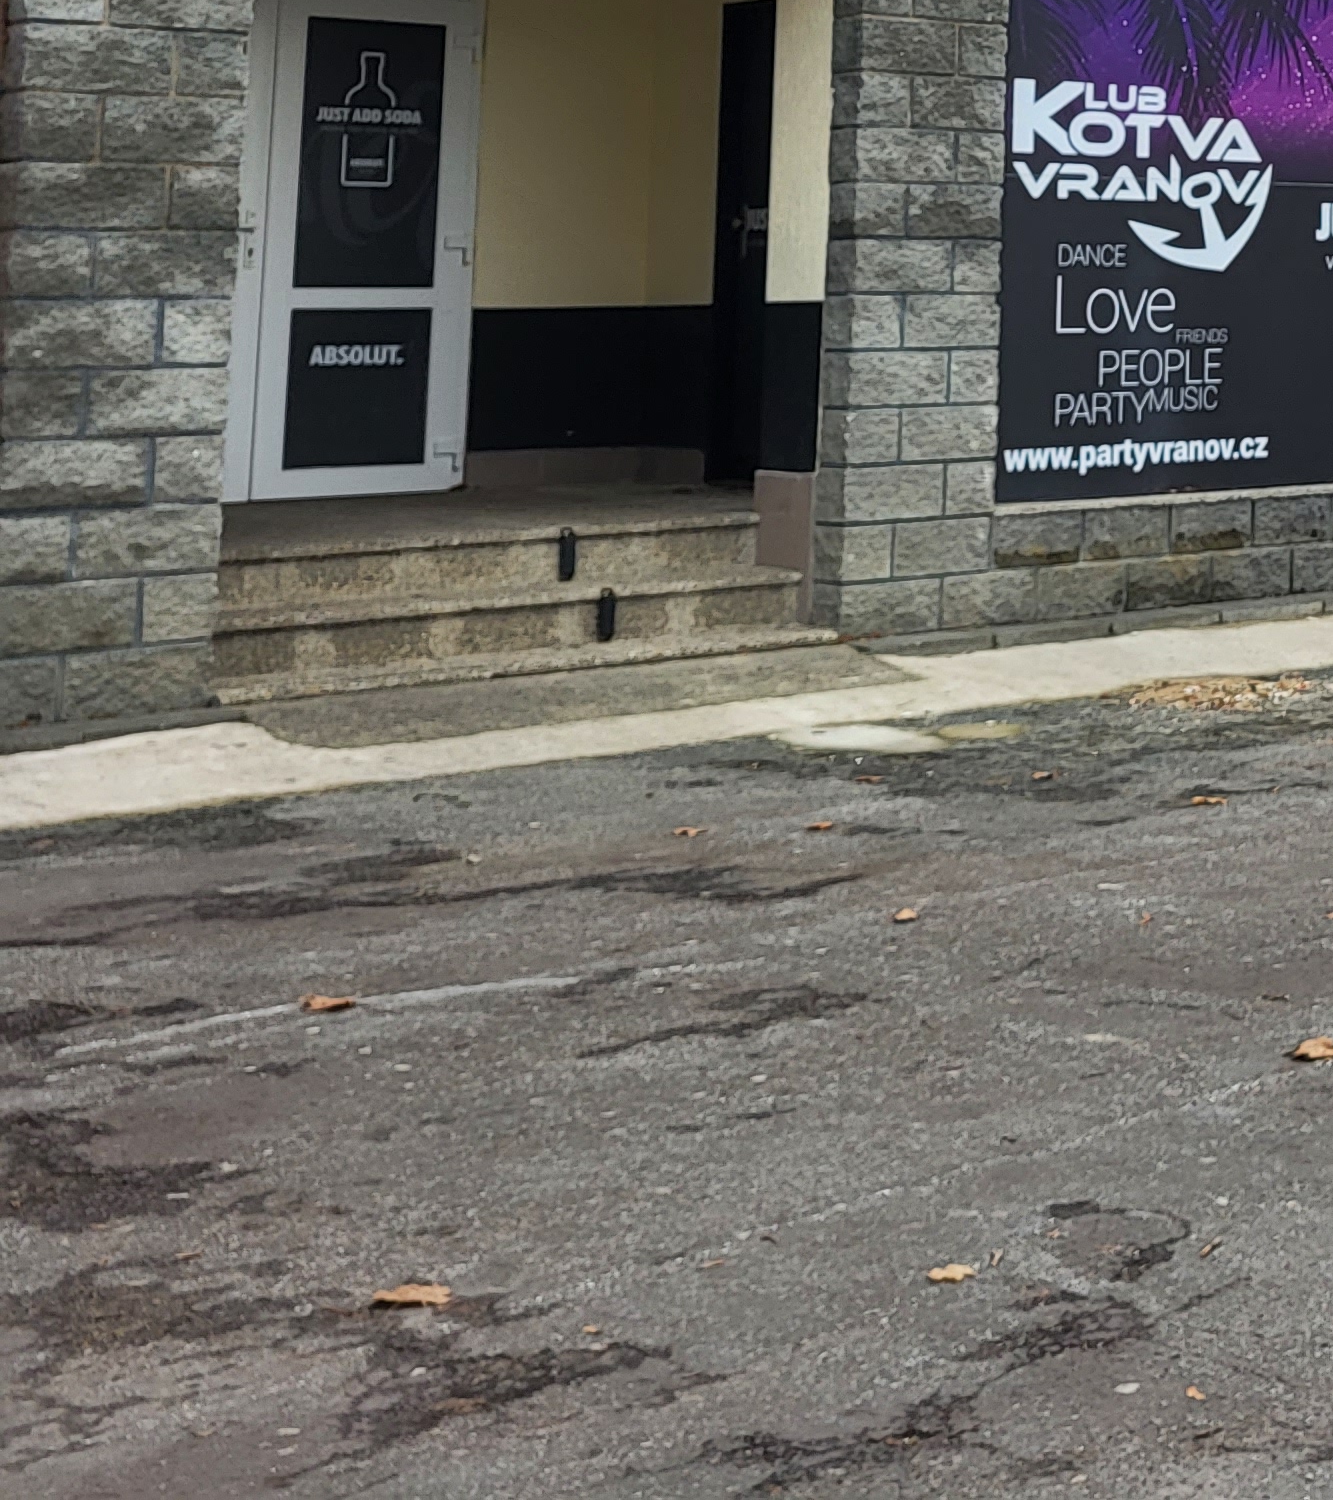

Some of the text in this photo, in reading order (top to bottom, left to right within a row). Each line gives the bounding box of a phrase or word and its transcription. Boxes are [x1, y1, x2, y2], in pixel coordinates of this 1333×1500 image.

[316, 105, 422, 125] JUST ADD SODA
[1012, 77, 1167, 156] KLUB
[1012, 77, 1263, 163] KOTVA
[1012, 154, 1262, 210] VRANOV
[1057, 243, 1128, 268] DANCE
[1055, 274, 1177, 334] Love
[1175, 327, 1229, 344] FRIENDS
[1098, 347, 1224, 388] PEOPLE
[1054, 385, 1219, 428] PARTY MUSIC
[1003, 436, 1270, 476] www.partyvranov.cz
